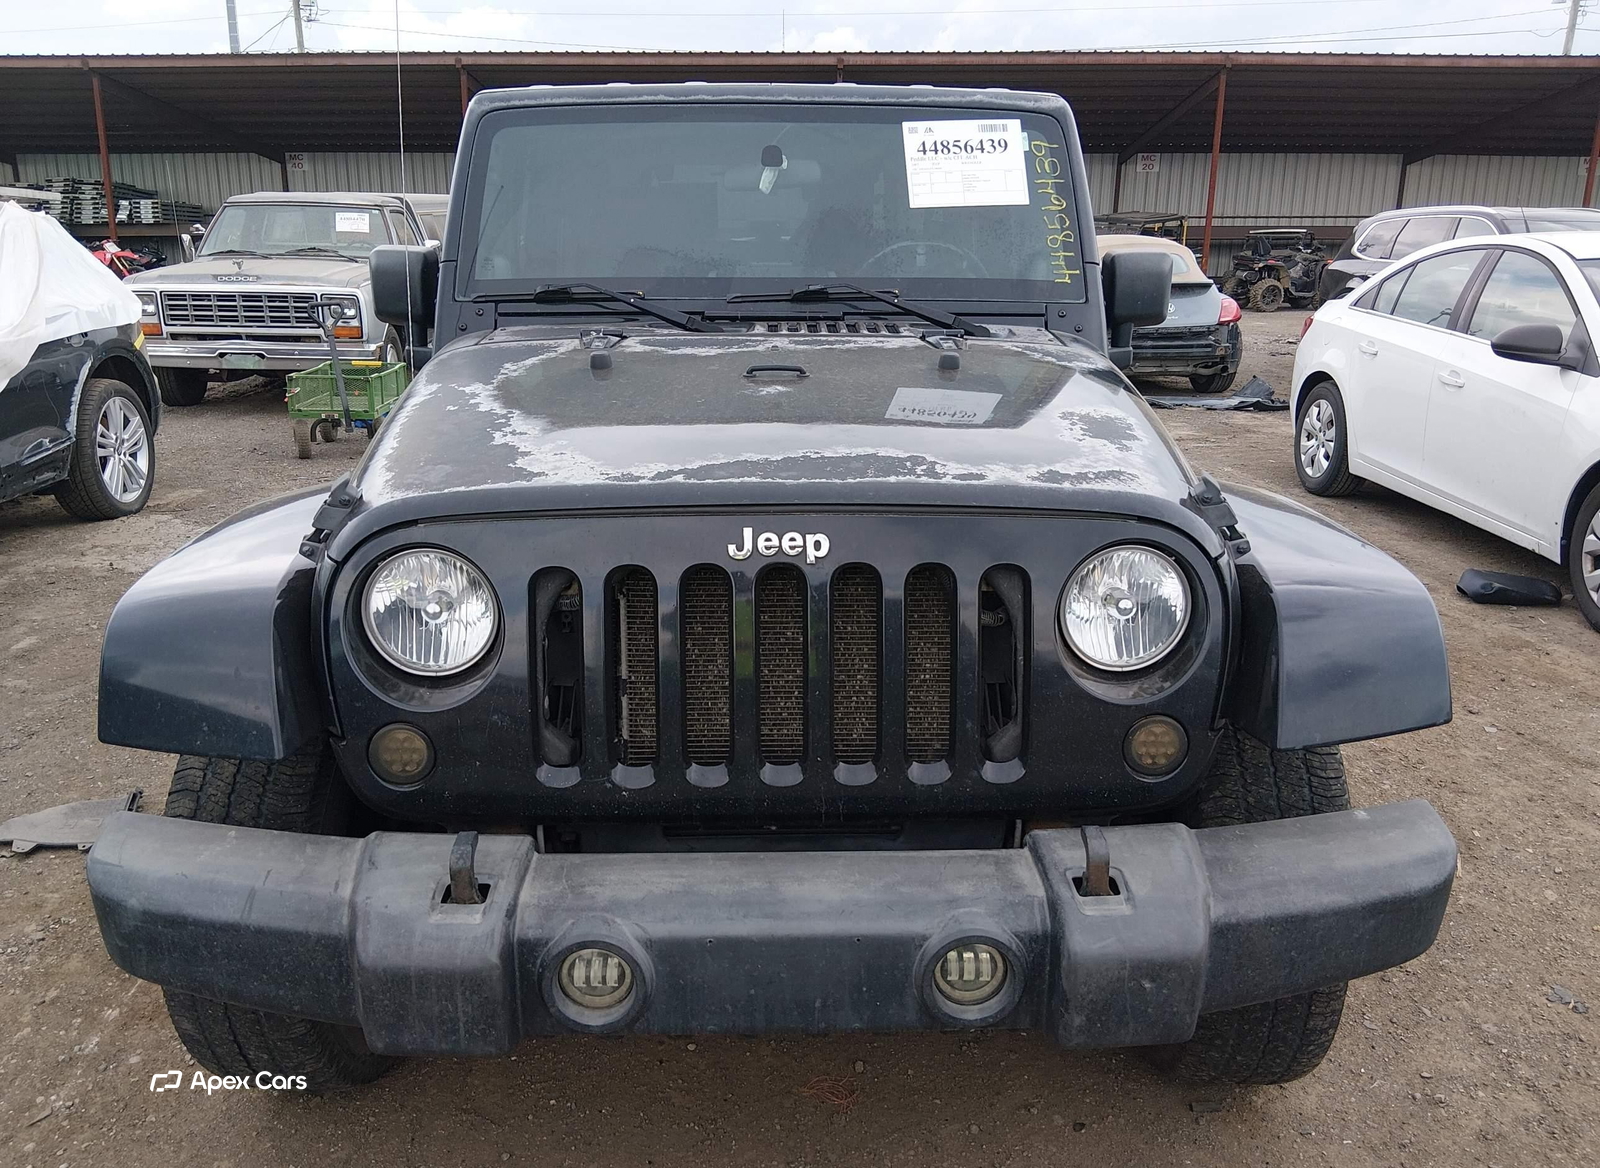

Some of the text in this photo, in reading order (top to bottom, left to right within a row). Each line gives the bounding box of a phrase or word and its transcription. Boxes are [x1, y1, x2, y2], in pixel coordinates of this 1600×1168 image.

[917, 138, 1008, 155] 44856439
[291, 162, 304, 170] 40
[1141, 163, 1155, 171] 20
[1031, 141, 1080, 283] 44856439
[727, 527, 830, 564] Jeep
